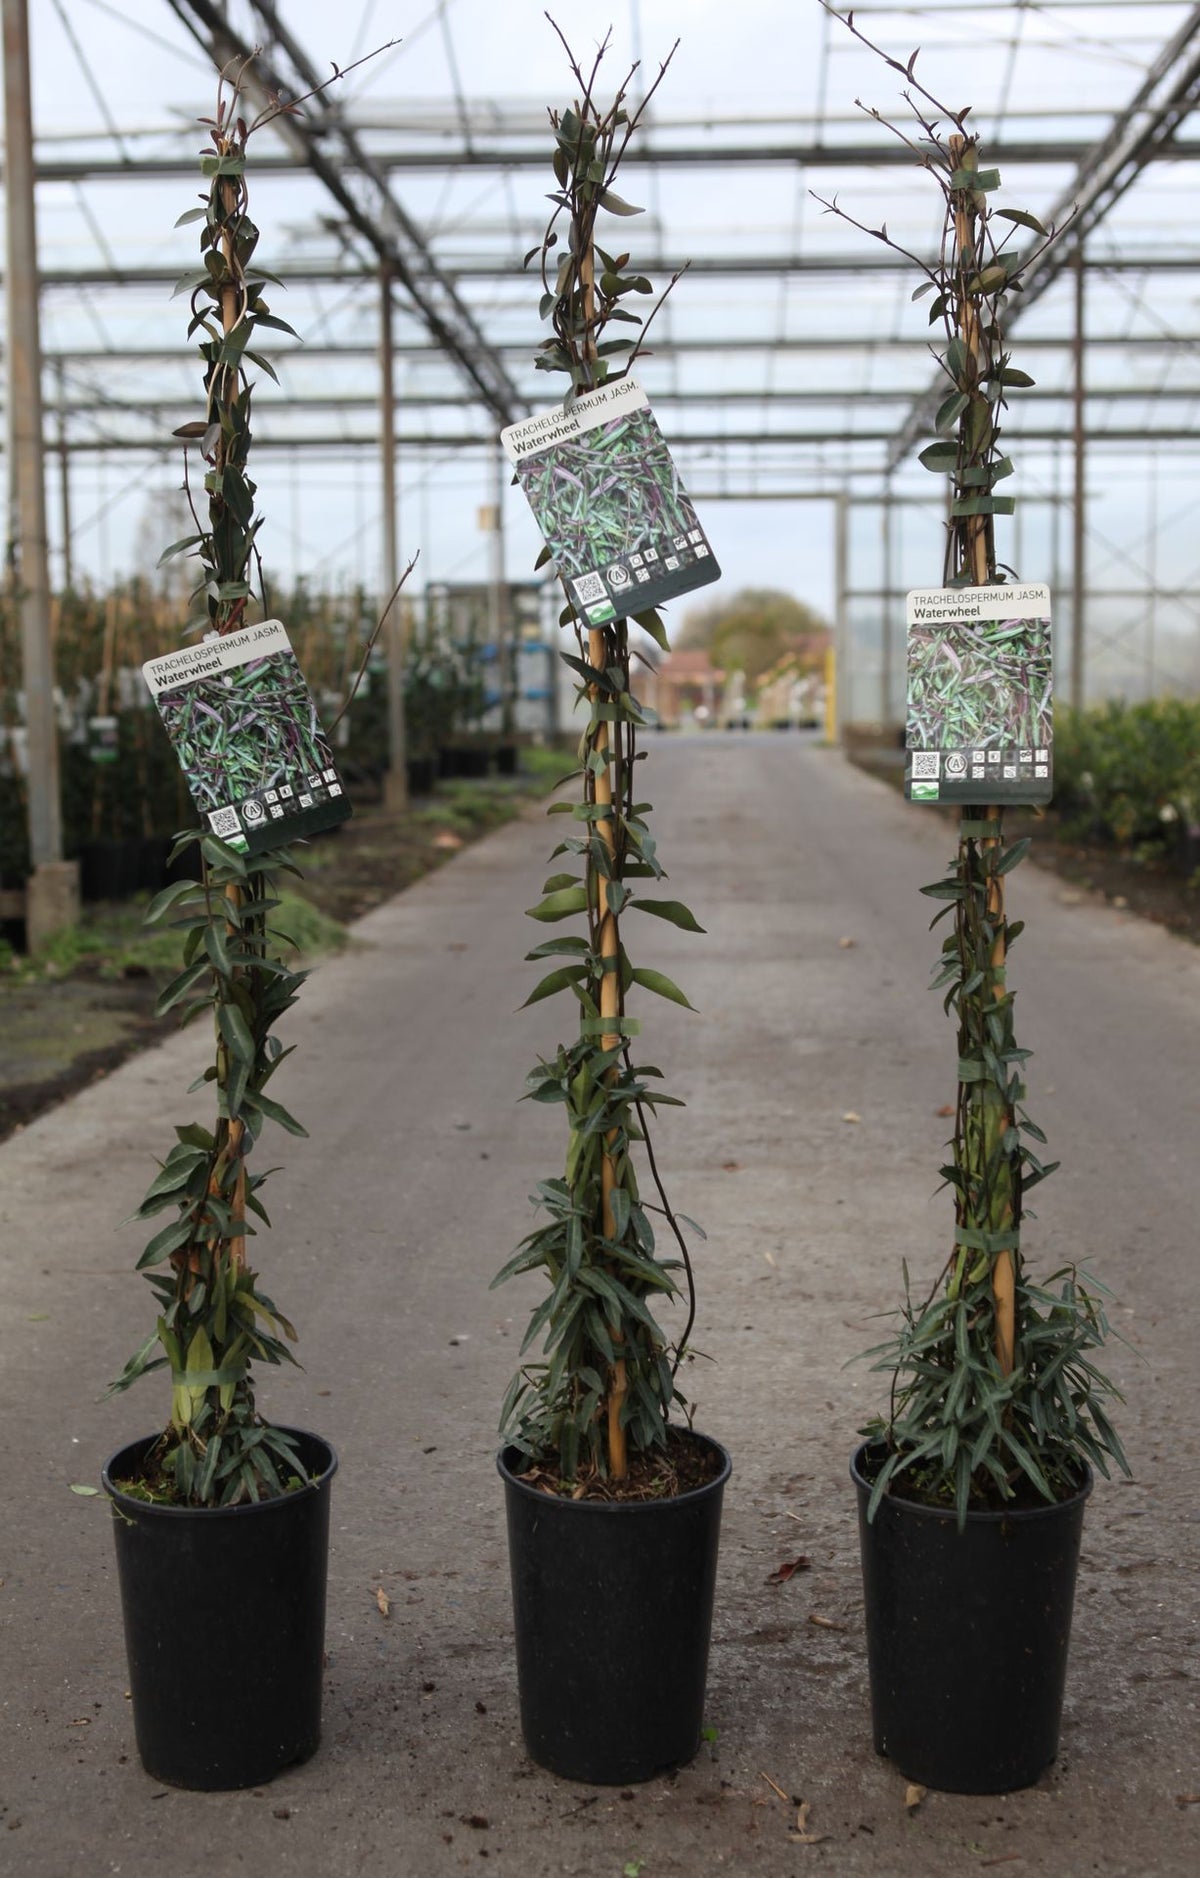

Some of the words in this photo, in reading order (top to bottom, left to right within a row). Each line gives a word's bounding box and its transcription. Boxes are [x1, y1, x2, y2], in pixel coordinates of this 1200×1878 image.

[610, 381, 639, 400] JASM.
[513, 418, 582, 454] Waterwheel
[914, 592, 1014, 606] TRACHELOSPERMUM
[1016, 590, 1047, 601] JASM.
[914, 606, 981, 619] Waterwheel
[150, 635, 250, 675] TRACHELOSPERMUM
[252, 625, 282, 642] JASM.
[154, 657, 223, 687] Waterwheel
